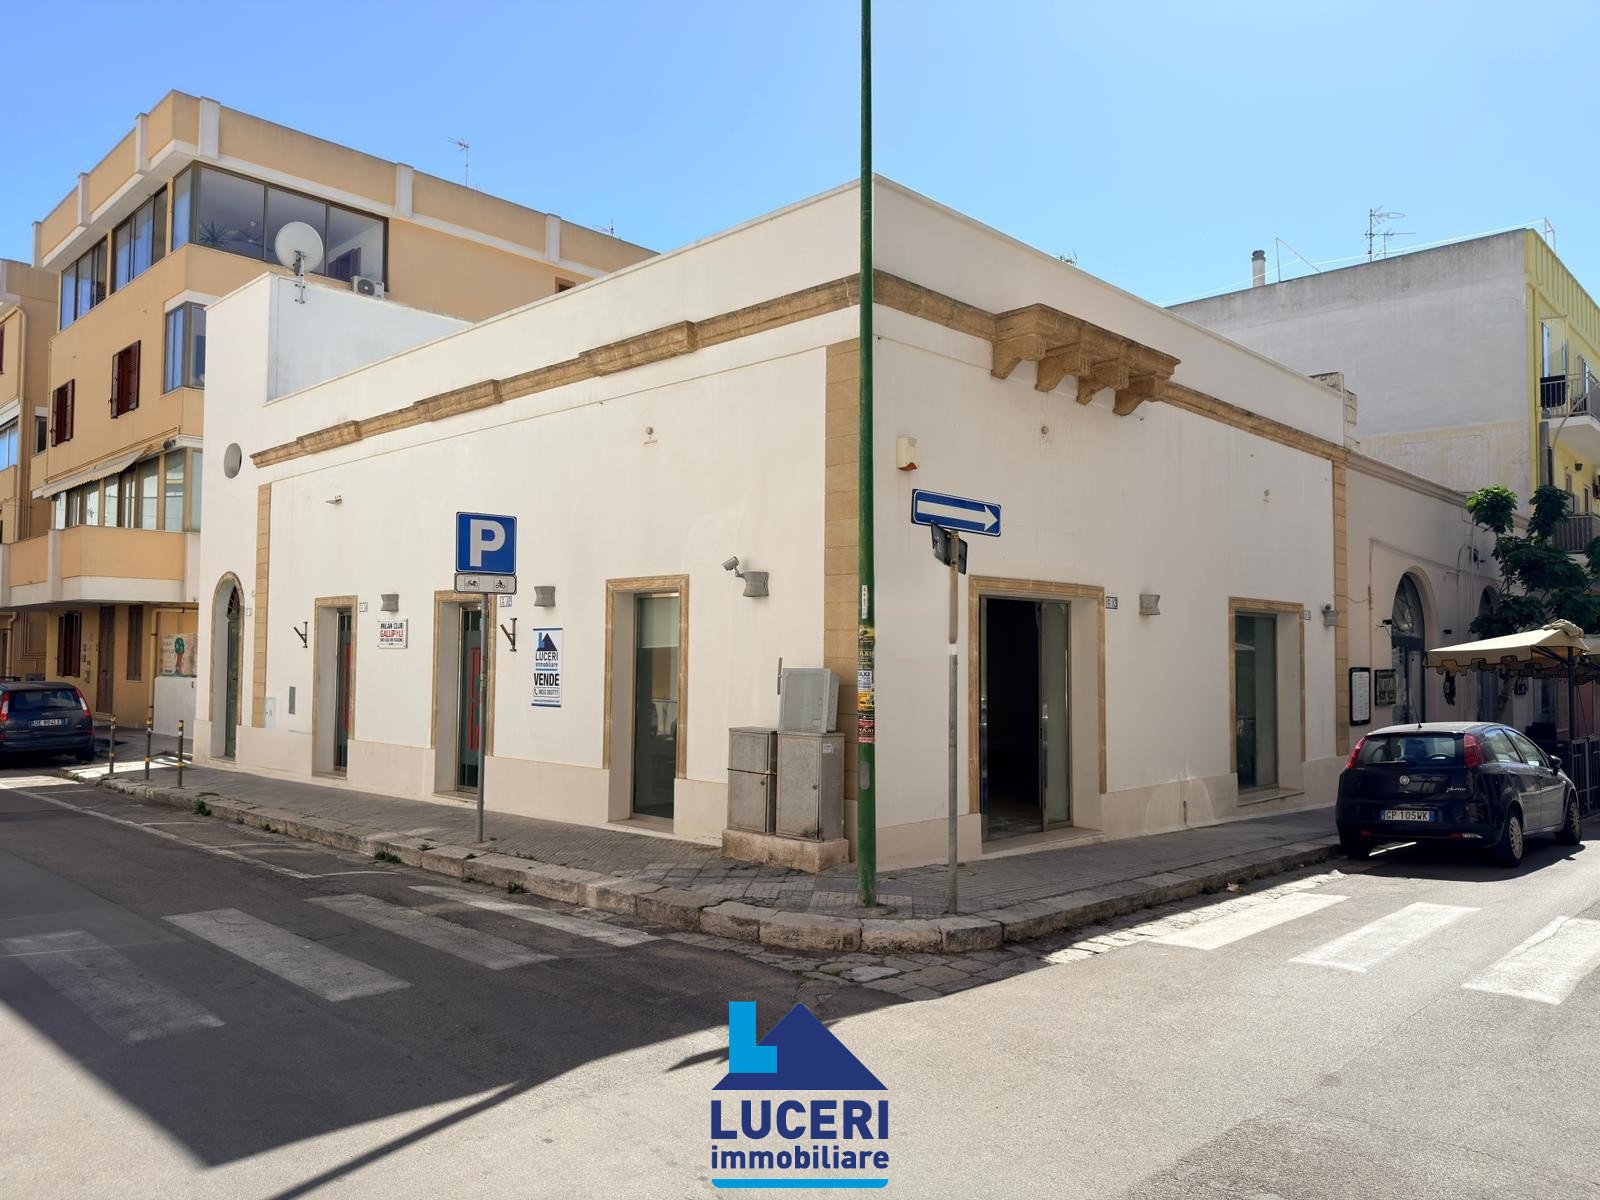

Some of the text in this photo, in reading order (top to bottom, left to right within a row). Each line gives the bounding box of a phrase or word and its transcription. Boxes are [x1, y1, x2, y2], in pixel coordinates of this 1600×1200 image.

[469, 518, 506, 568] P
[380, 622, 404, 630] MILAN CLUB
[535, 651, 559, 661] LUCERI
[533, 672, 560, 687] VENDE
[1400, 811, 1428, 821] 105WK
